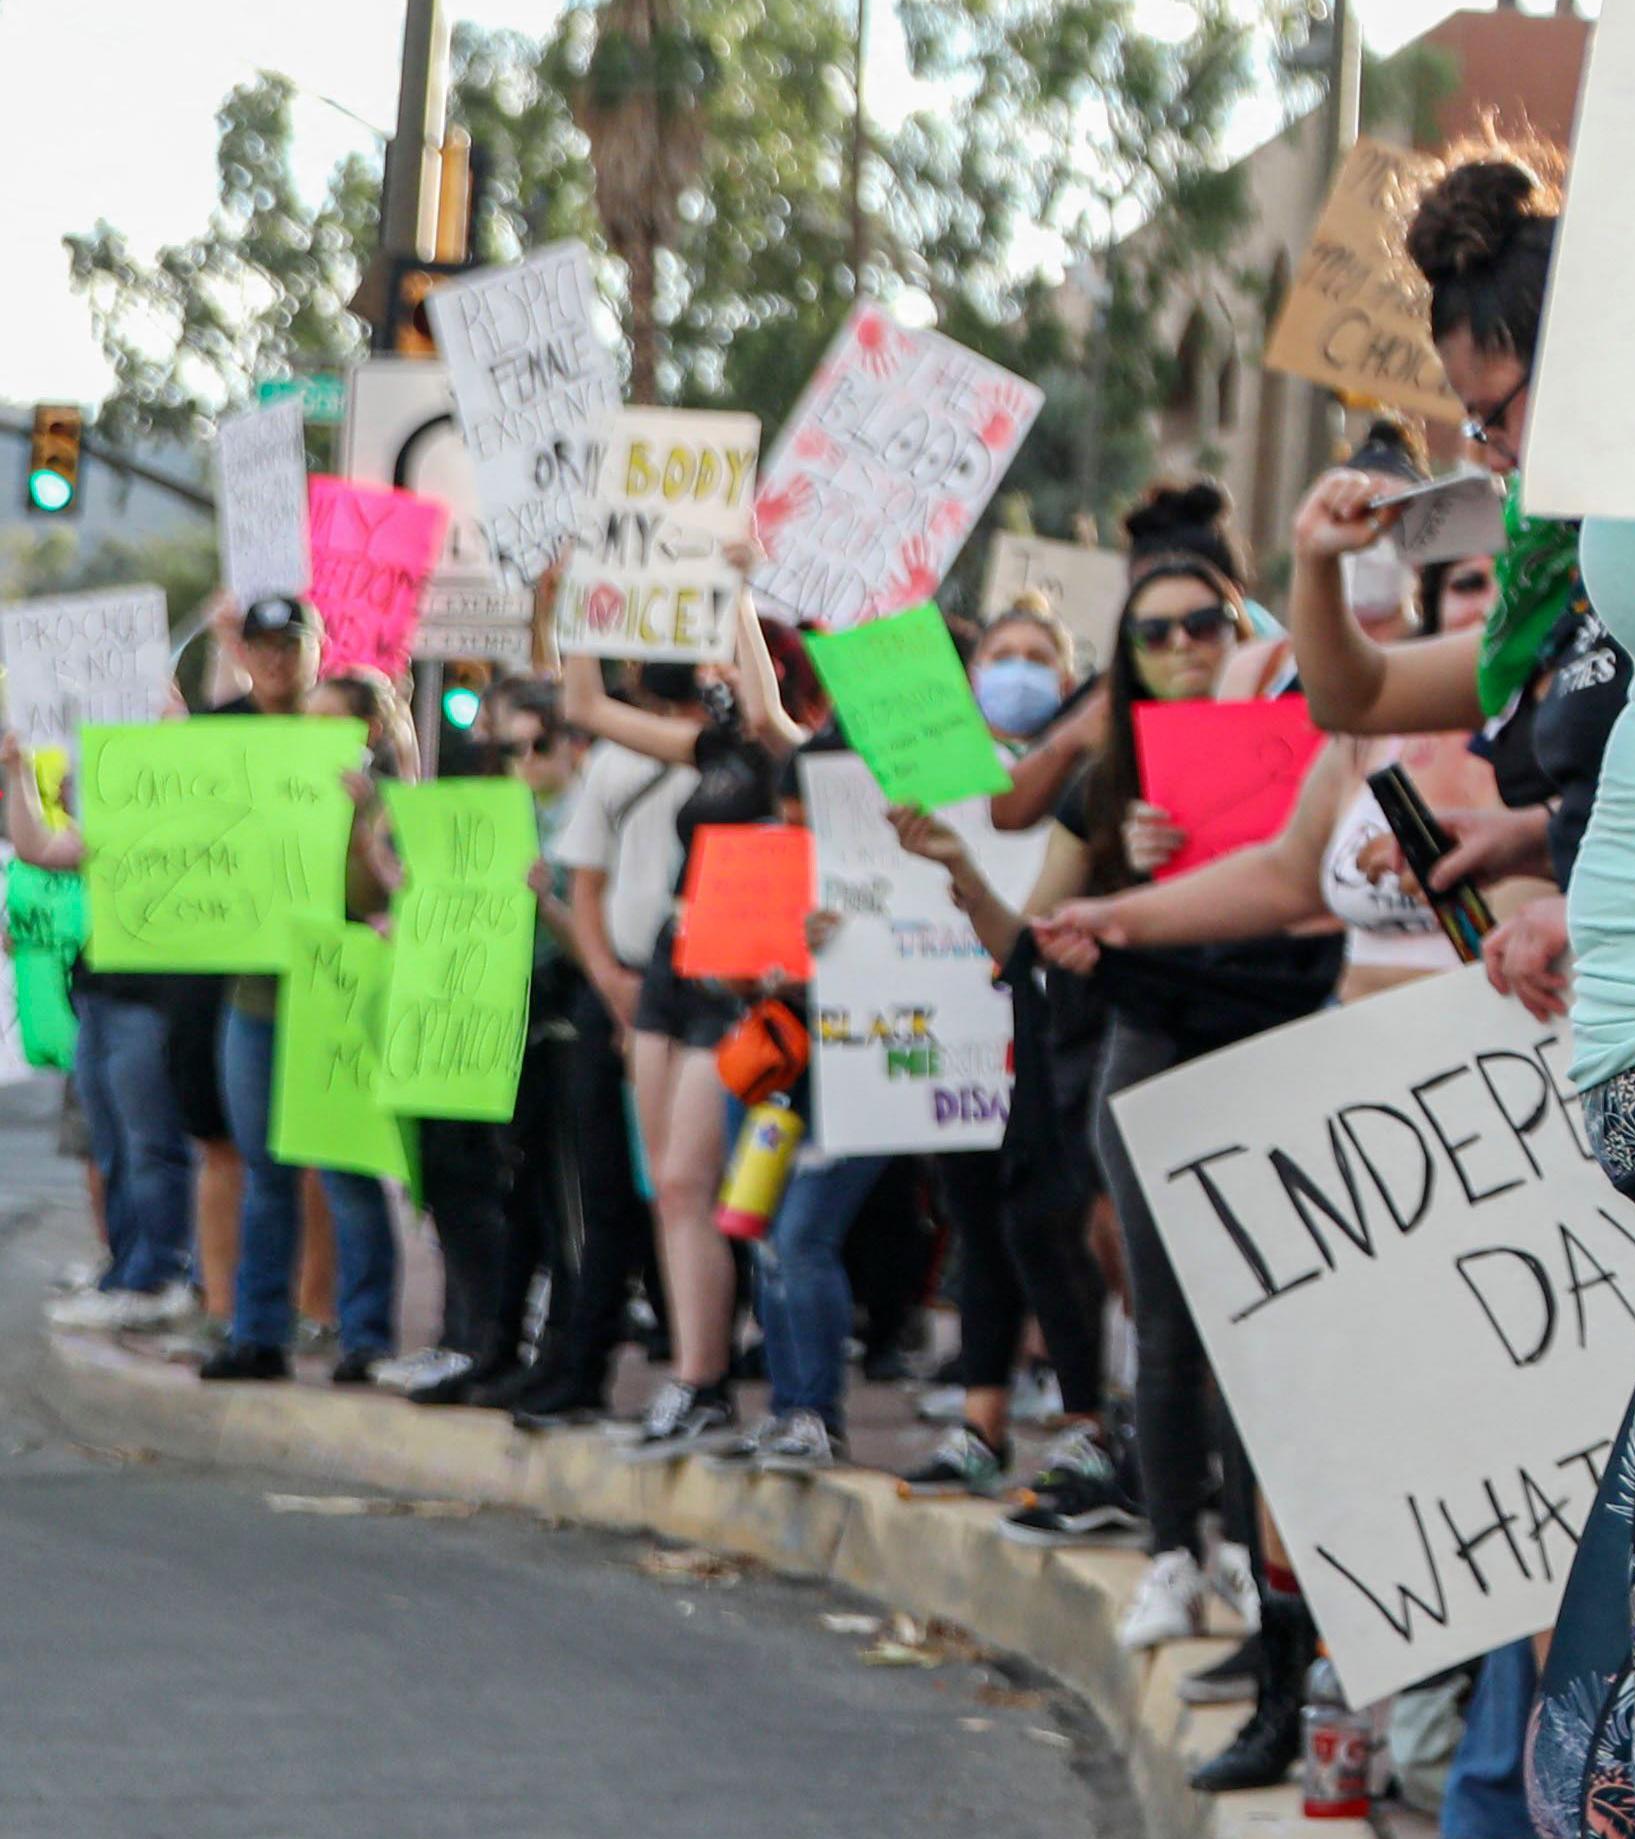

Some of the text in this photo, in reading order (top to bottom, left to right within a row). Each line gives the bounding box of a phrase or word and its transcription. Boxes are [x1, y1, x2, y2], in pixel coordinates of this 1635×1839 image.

[623, 437, 758, 508] BODY
[600, 510, 667, 569] MY
[95, 735, 256, 812] Cancel
[451, 808, 497, 881] NO
[415, 886, 518, 945] UTERUS
[440, 940, 489, 998] NO
[386, 1000, 514, 1082] OPINION
[816, 1001, 940, 1049] BLACK
